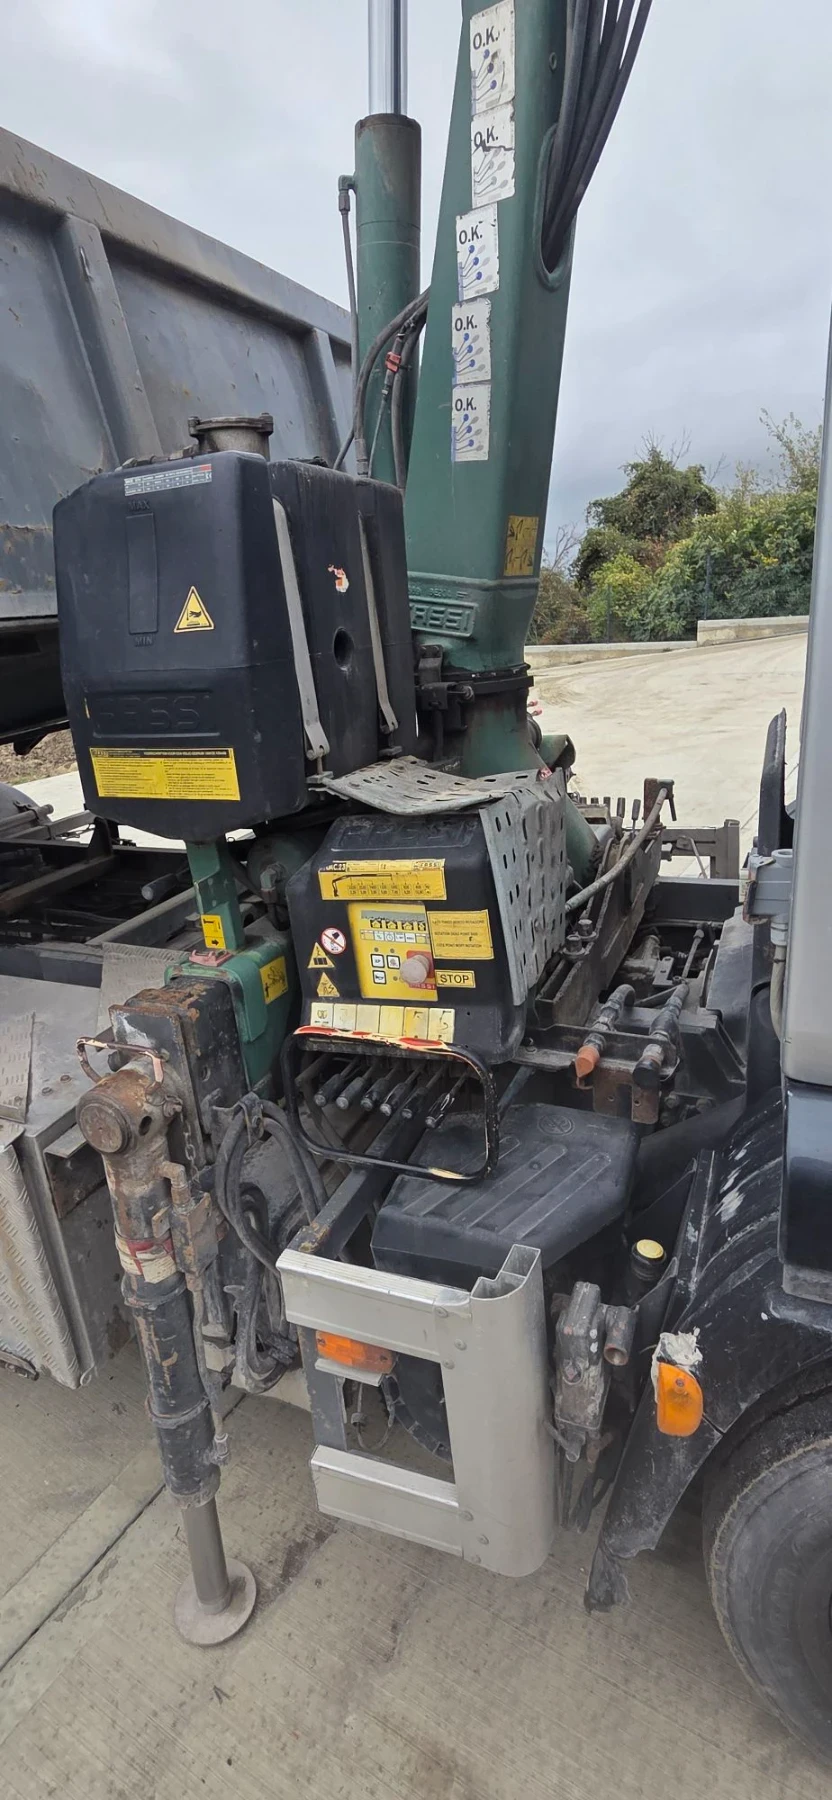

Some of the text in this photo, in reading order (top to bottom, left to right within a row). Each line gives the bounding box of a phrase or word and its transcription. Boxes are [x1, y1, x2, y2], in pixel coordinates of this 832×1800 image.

[473, 25, 499, 50] O.K.
[473, 125, 499, 148] O.K.
[459, 224, 483, 245] O.K.
[454, 314, 478, 332] O.K.
[454, 397, 477, 412] O.K.
[128, 499, 151, 511] MAX
[134, 635, 153, 646] MIN
[440, 974, 470, 984] STOP
